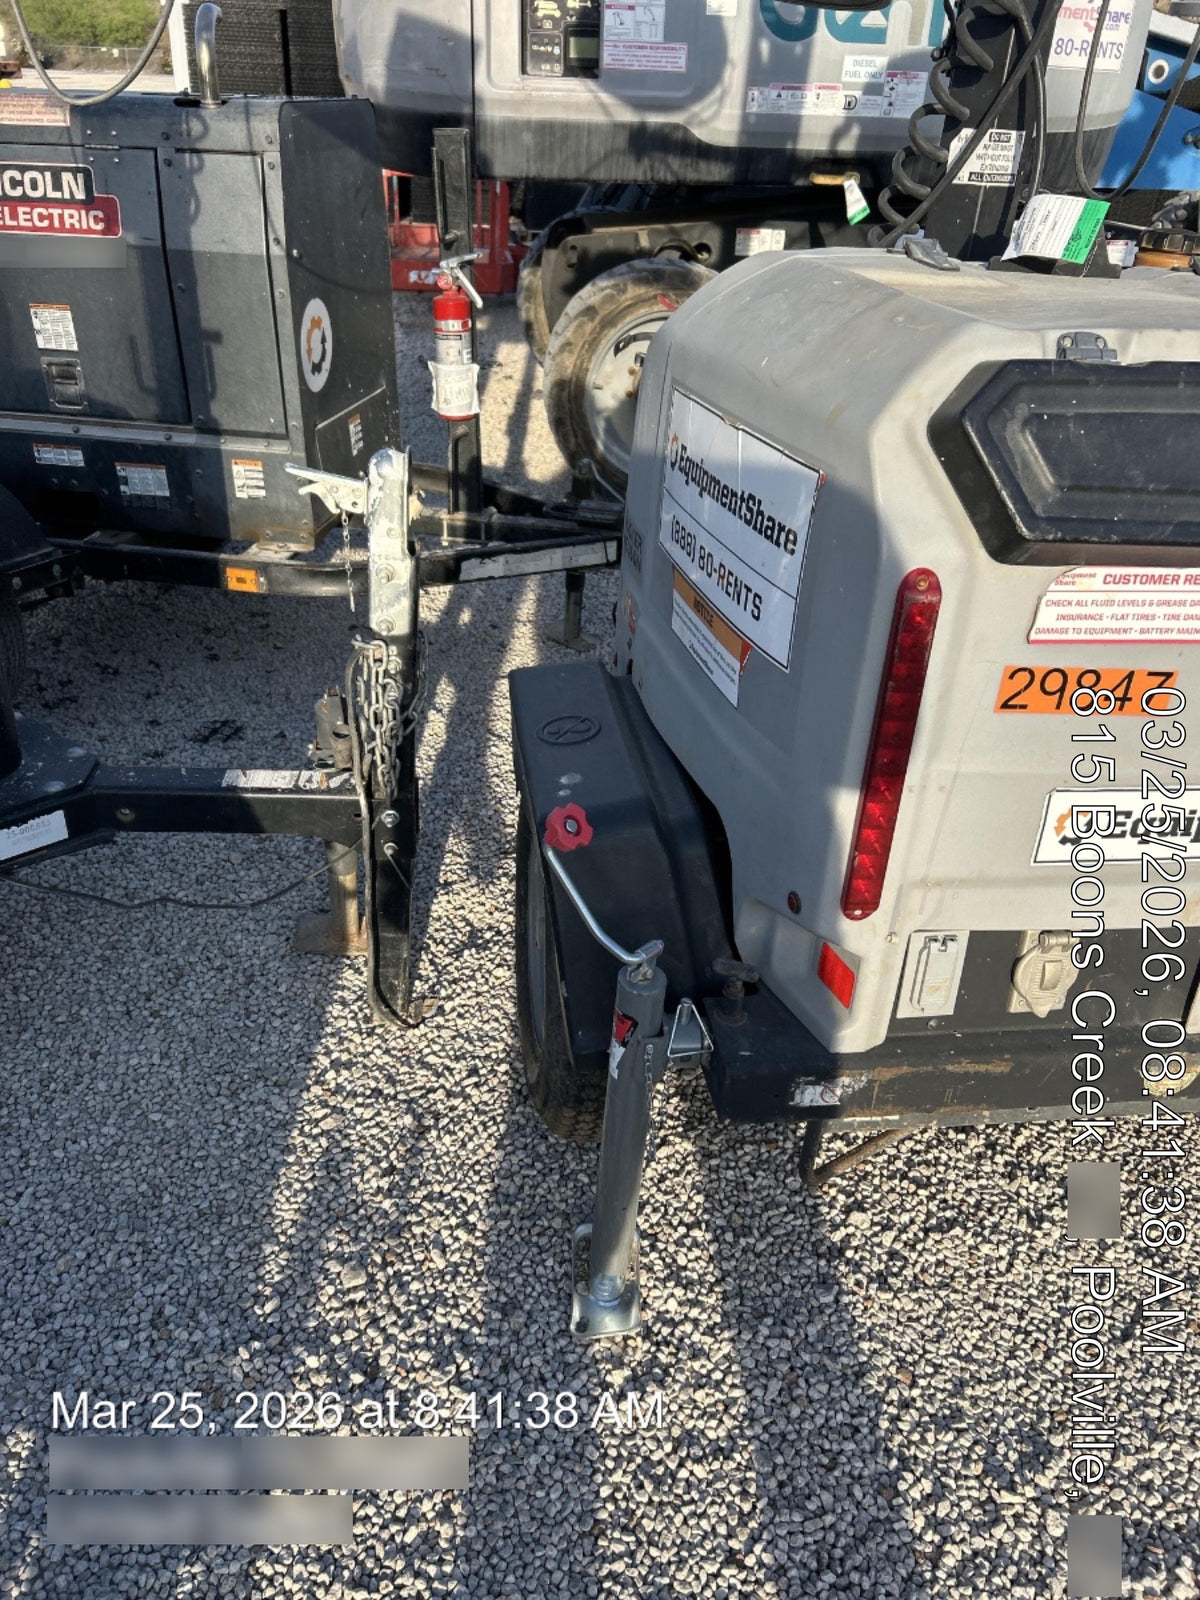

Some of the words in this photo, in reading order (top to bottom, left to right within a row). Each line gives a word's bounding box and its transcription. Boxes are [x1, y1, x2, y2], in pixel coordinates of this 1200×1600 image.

[1054, 38, 1124, 60] 80-RNTS
[852, 59, 878, 69] DIESEL
[844, 71, 863, 79] FUEL
[864, 72, 883, 80] ONLY
[0, 169, 86, 200] COLN
[680, 444, 798, 556] EquipmentShare
[671, 515, 697, 563] (888)
[698, 545, 763, 622] 80-RENTS
[1103, 574, 1180, 586] CUSTOMER
[1045, 600, 1073, 608] CHECK
[1074, 600, 1089, 608] ALL
[1090, 600, 1116, 608] FLUID
[1117, 600, 1146, 608] LEVELS
[1156, 600, 1187, 608] GREASE
[1056, 613, 1104, 621] INSURANCE
[1110, 613, 1130, 621] FLAT
[1132, 613, 1155, 621] TIRES
[1000, 667, 1174, 712] 29847
